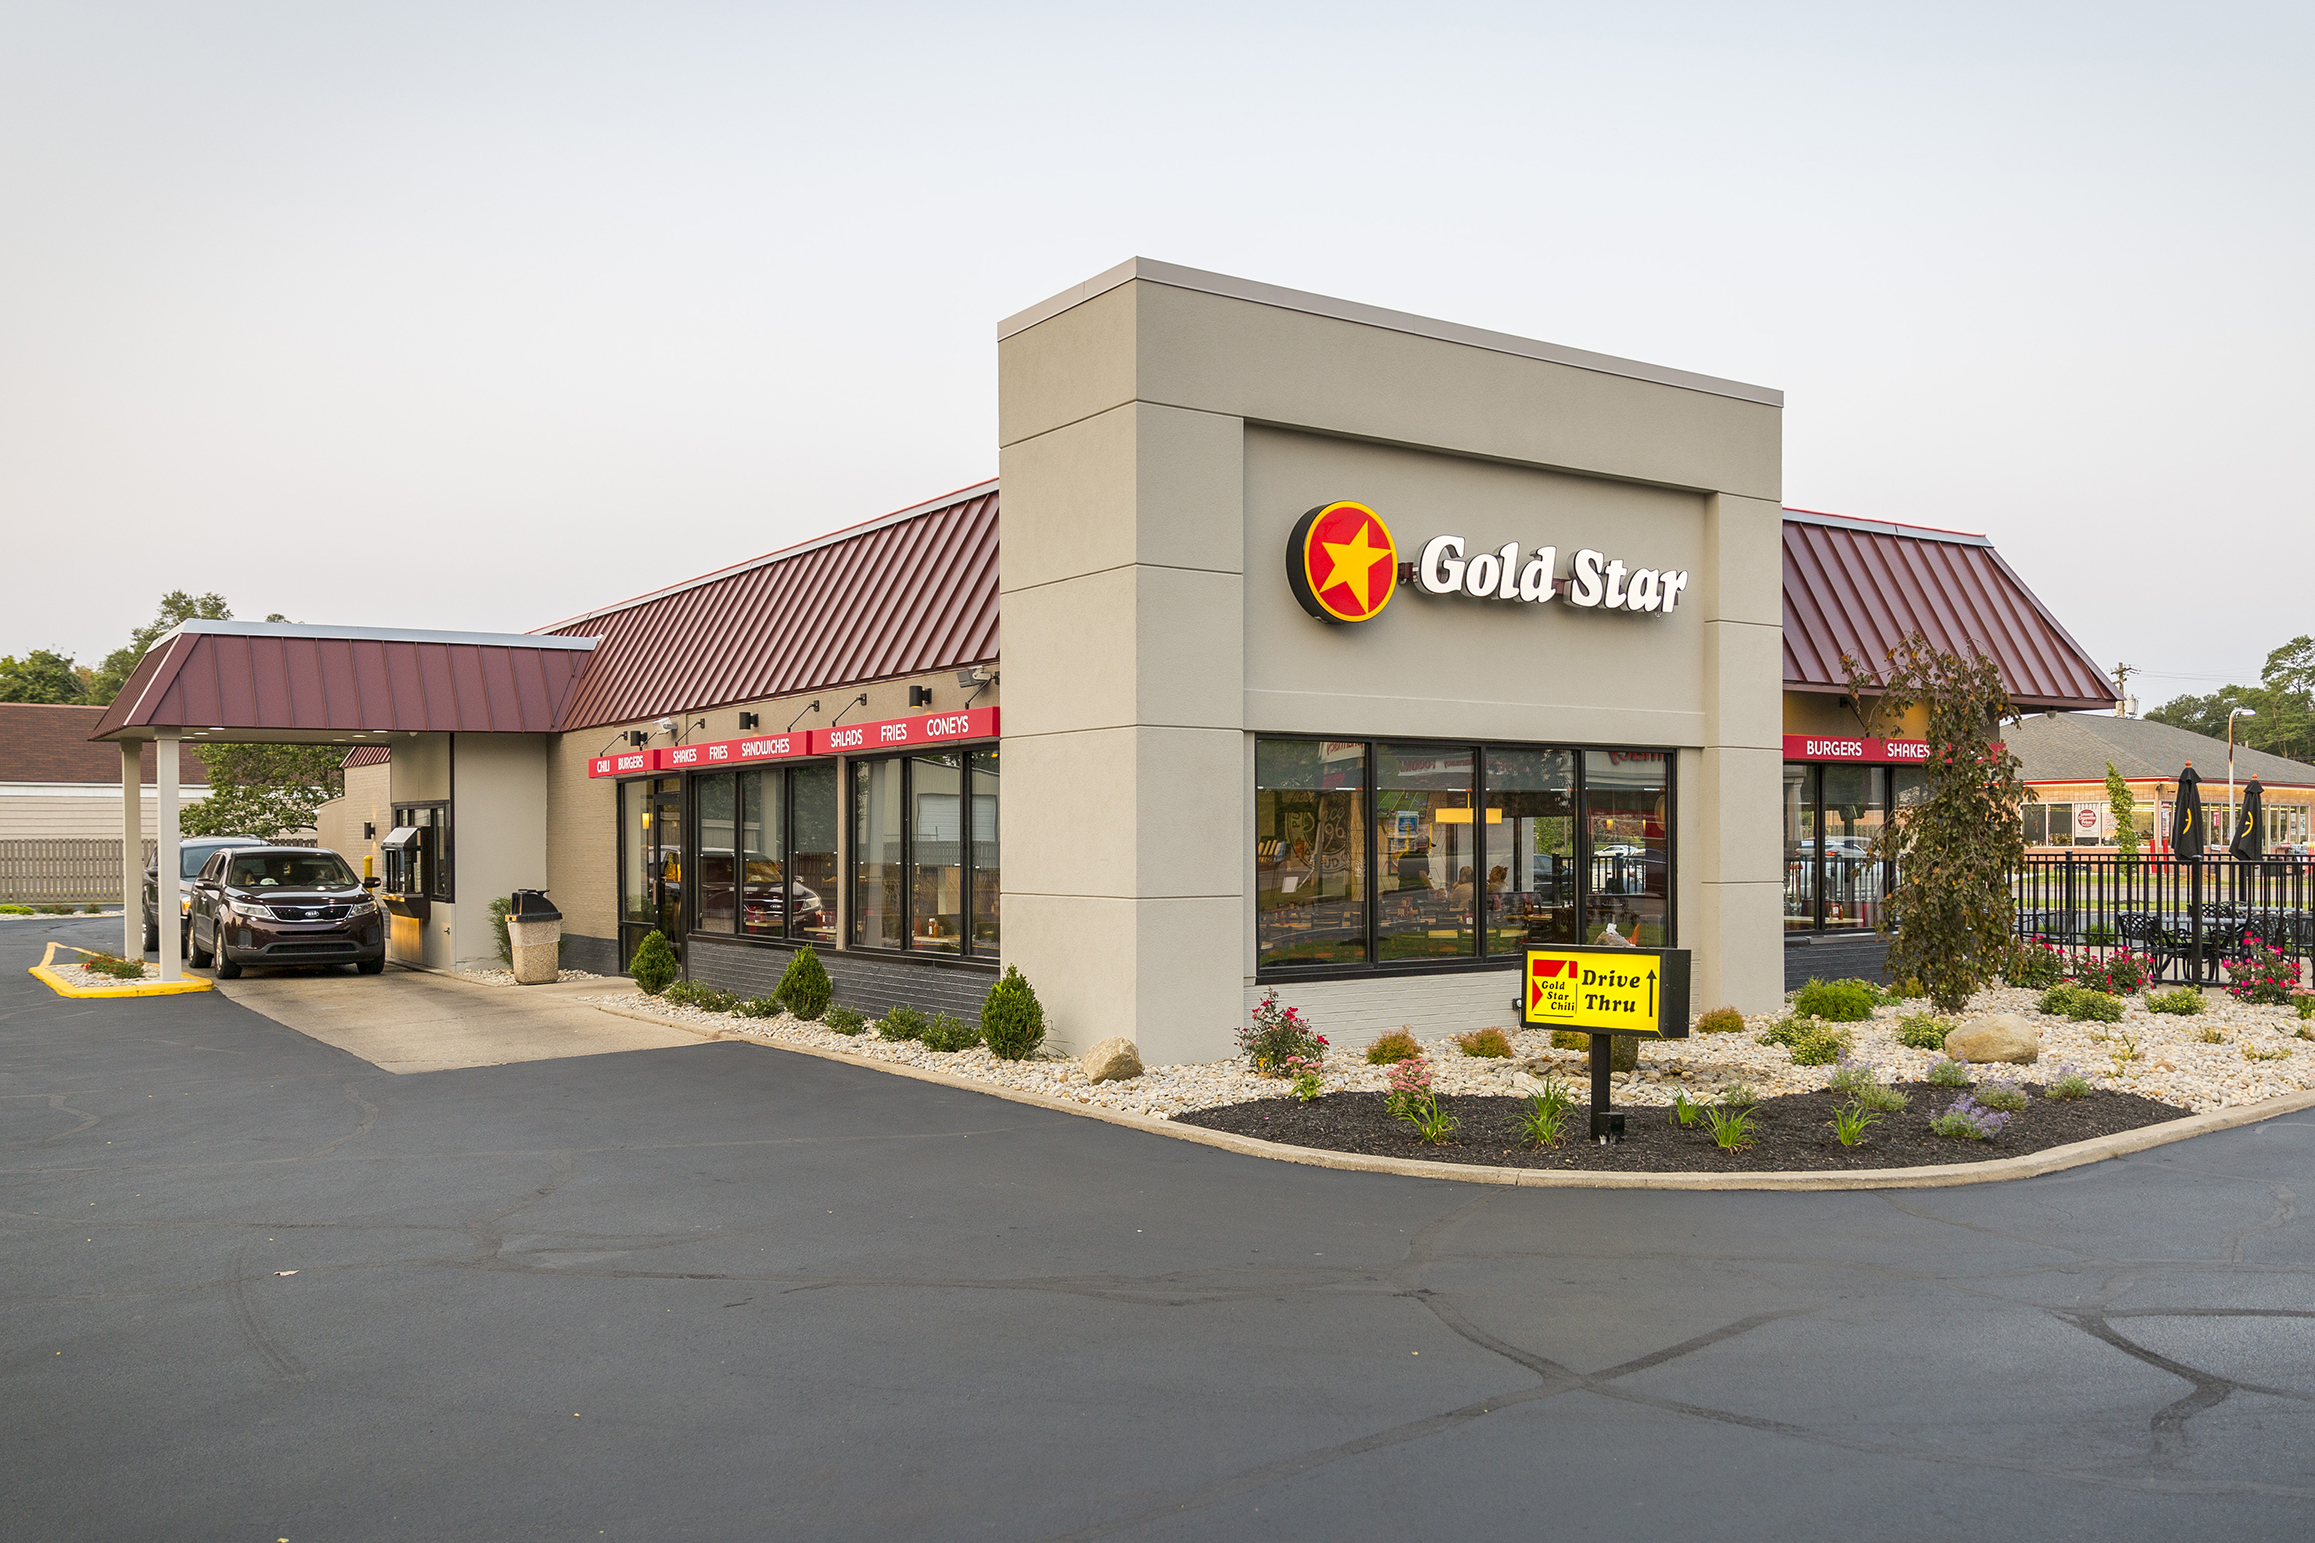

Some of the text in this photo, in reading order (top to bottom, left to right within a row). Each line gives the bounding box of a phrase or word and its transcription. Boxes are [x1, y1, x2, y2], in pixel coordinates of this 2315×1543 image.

[1418, 534, 1689, 613] Gold Star
[831, 715, 969, 748] SALADS FRIES CONEYS
[673, 738, 790, 764] SHAKES FRIES SANDWICHES
[1806, 740, 1931, 758] BURGERS SHAKES
[596, 755, 644, 773] CHILI BURGERS
[1541, 980, 1566, 990] Gold
[1581, 969, 1641, 988] Drive
[1546, 991, 1569, 1000] Star
[1584, 994, 1637, 1012] Thru
[1551, 1001, 1575, 1011] Chili
